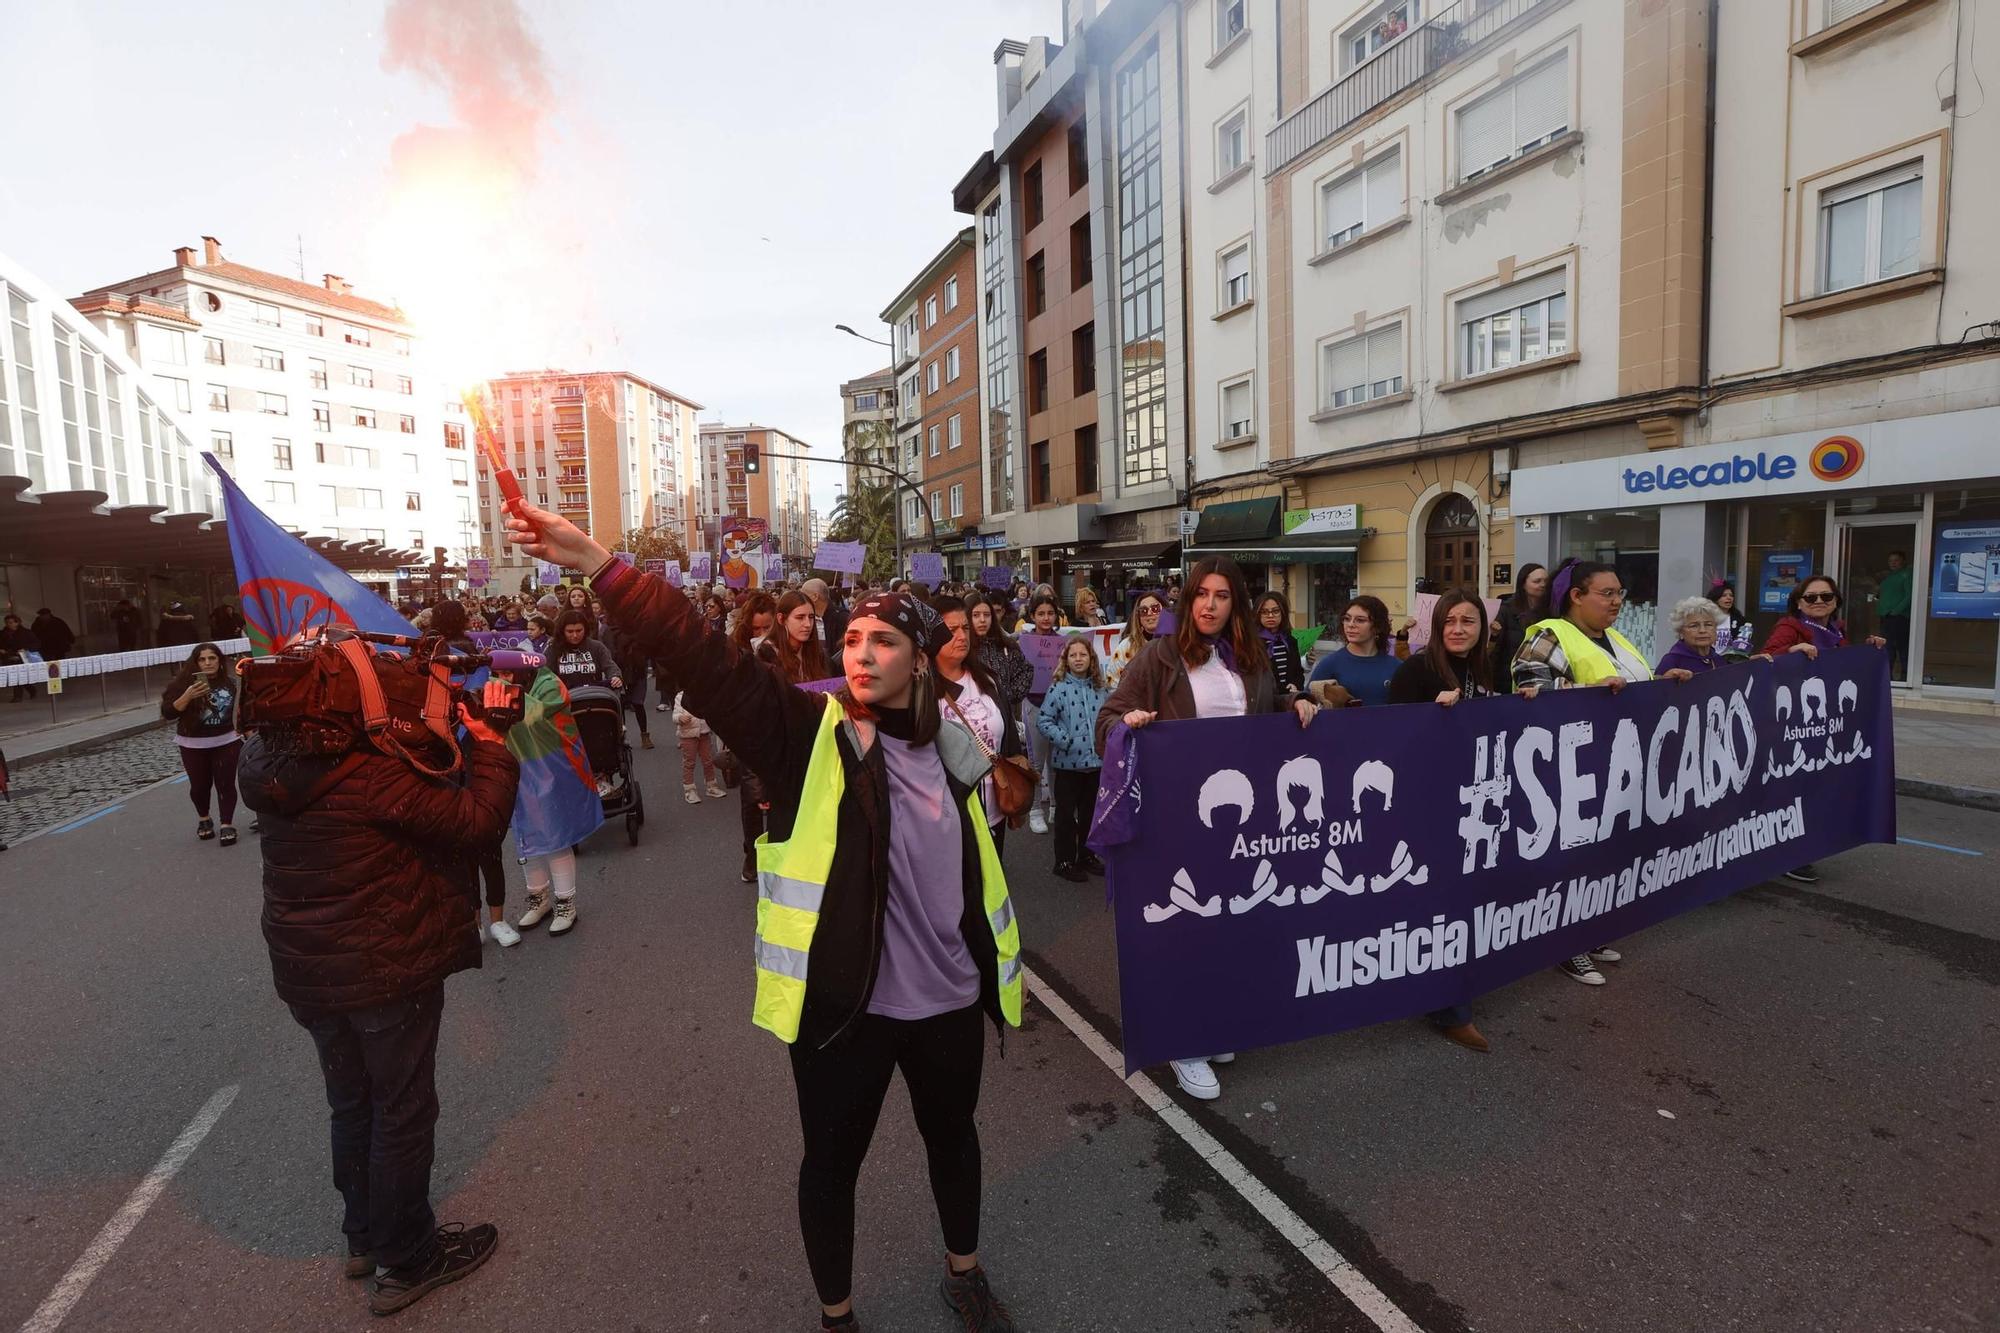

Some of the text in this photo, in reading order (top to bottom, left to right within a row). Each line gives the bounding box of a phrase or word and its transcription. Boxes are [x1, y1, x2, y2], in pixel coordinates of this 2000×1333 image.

[1623, 452, 1796, 493] telecable
[490, 637, 519, 650] ASO
[521, 653, 540, 668] tve
[393, 716, 412, 733] tve
[1784, 716, 1844, 742] Asturies 8M
[1458, 675, 1757, 874] #SEACABÓ
[1229, 818, 1364, 860] Asturies 8M
[1294, 914, 1468, 998] Xusticia
[1474, 880, 1562, 959] Verdá
[1562, 873, 1616, 927] Non
[1615, 865, 1641, 908] al
[1716, 797, 1805, 870] patriarcal
